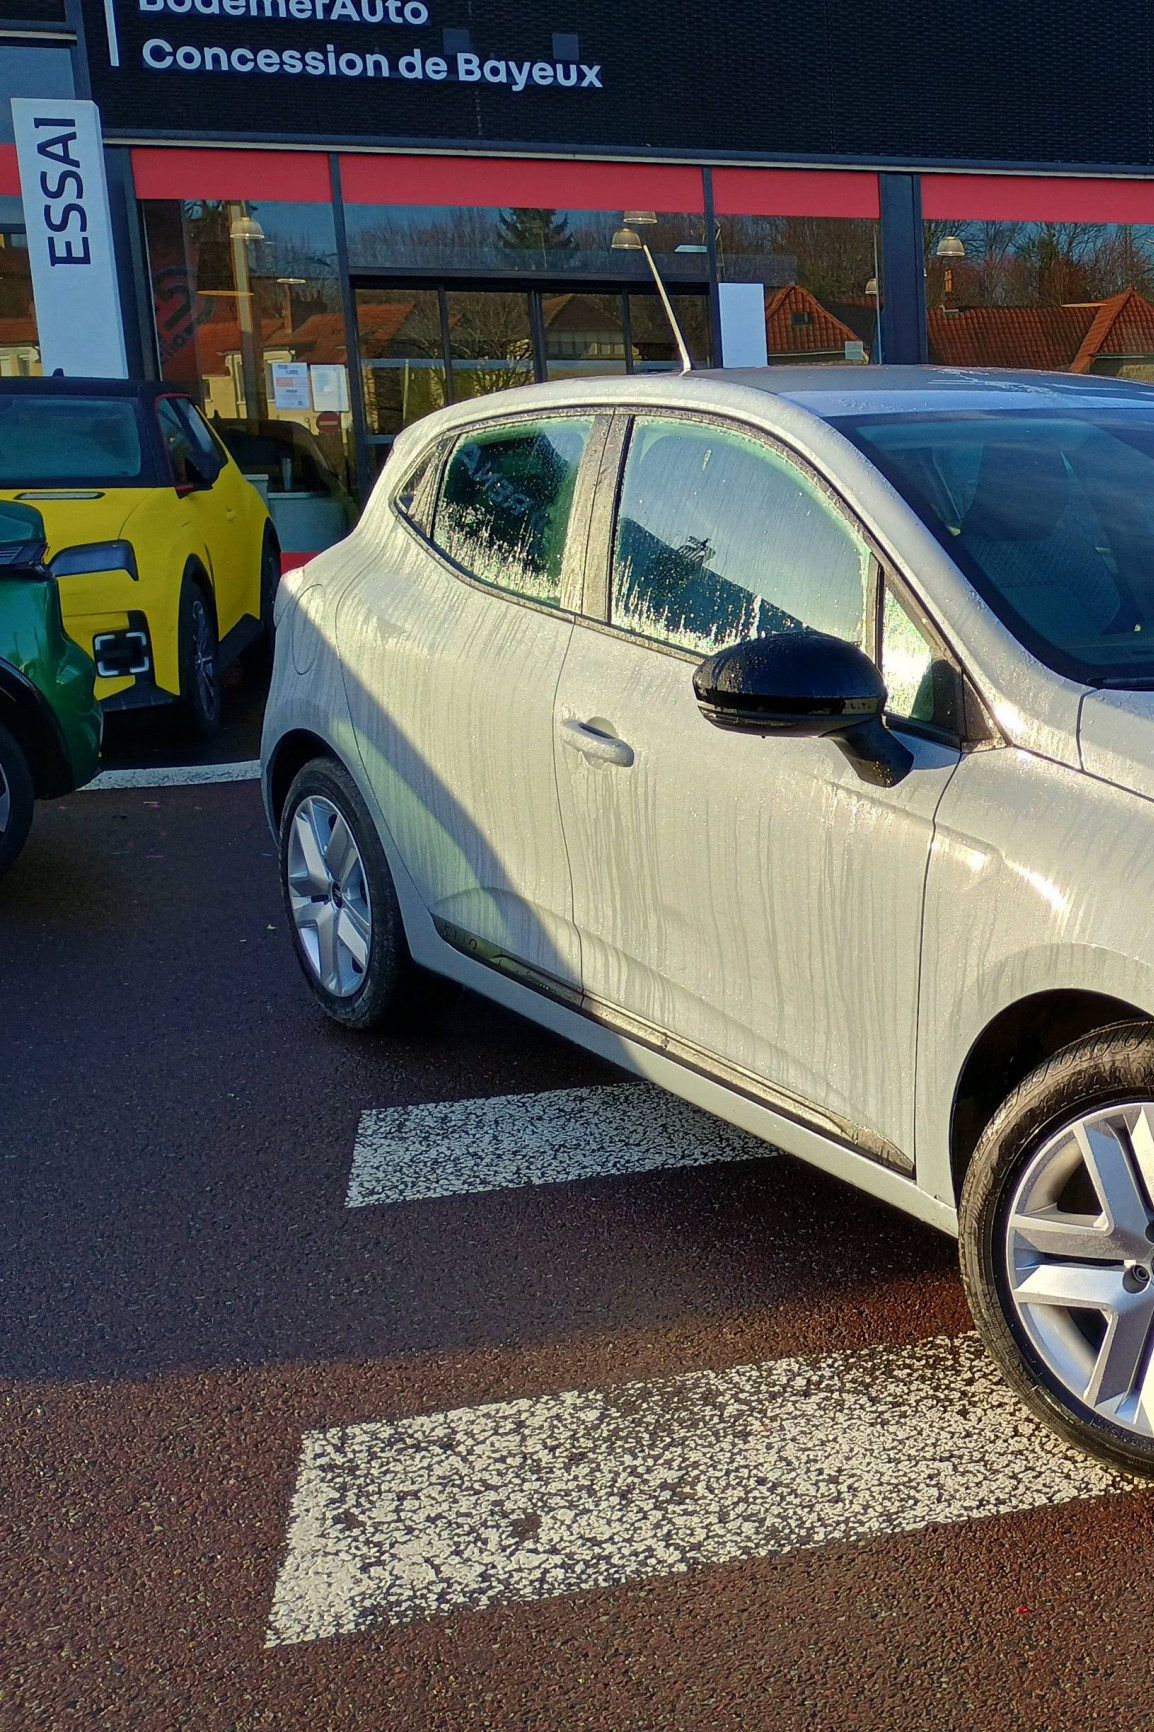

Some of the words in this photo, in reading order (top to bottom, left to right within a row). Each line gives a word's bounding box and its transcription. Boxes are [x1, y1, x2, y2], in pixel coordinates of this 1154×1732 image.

[142, 38, 390, 77] Concession
[398, 48, 448, 80] de
[456, 52, 603, 91] Bayeux
[33, 117, 91, 266] ESSAI
